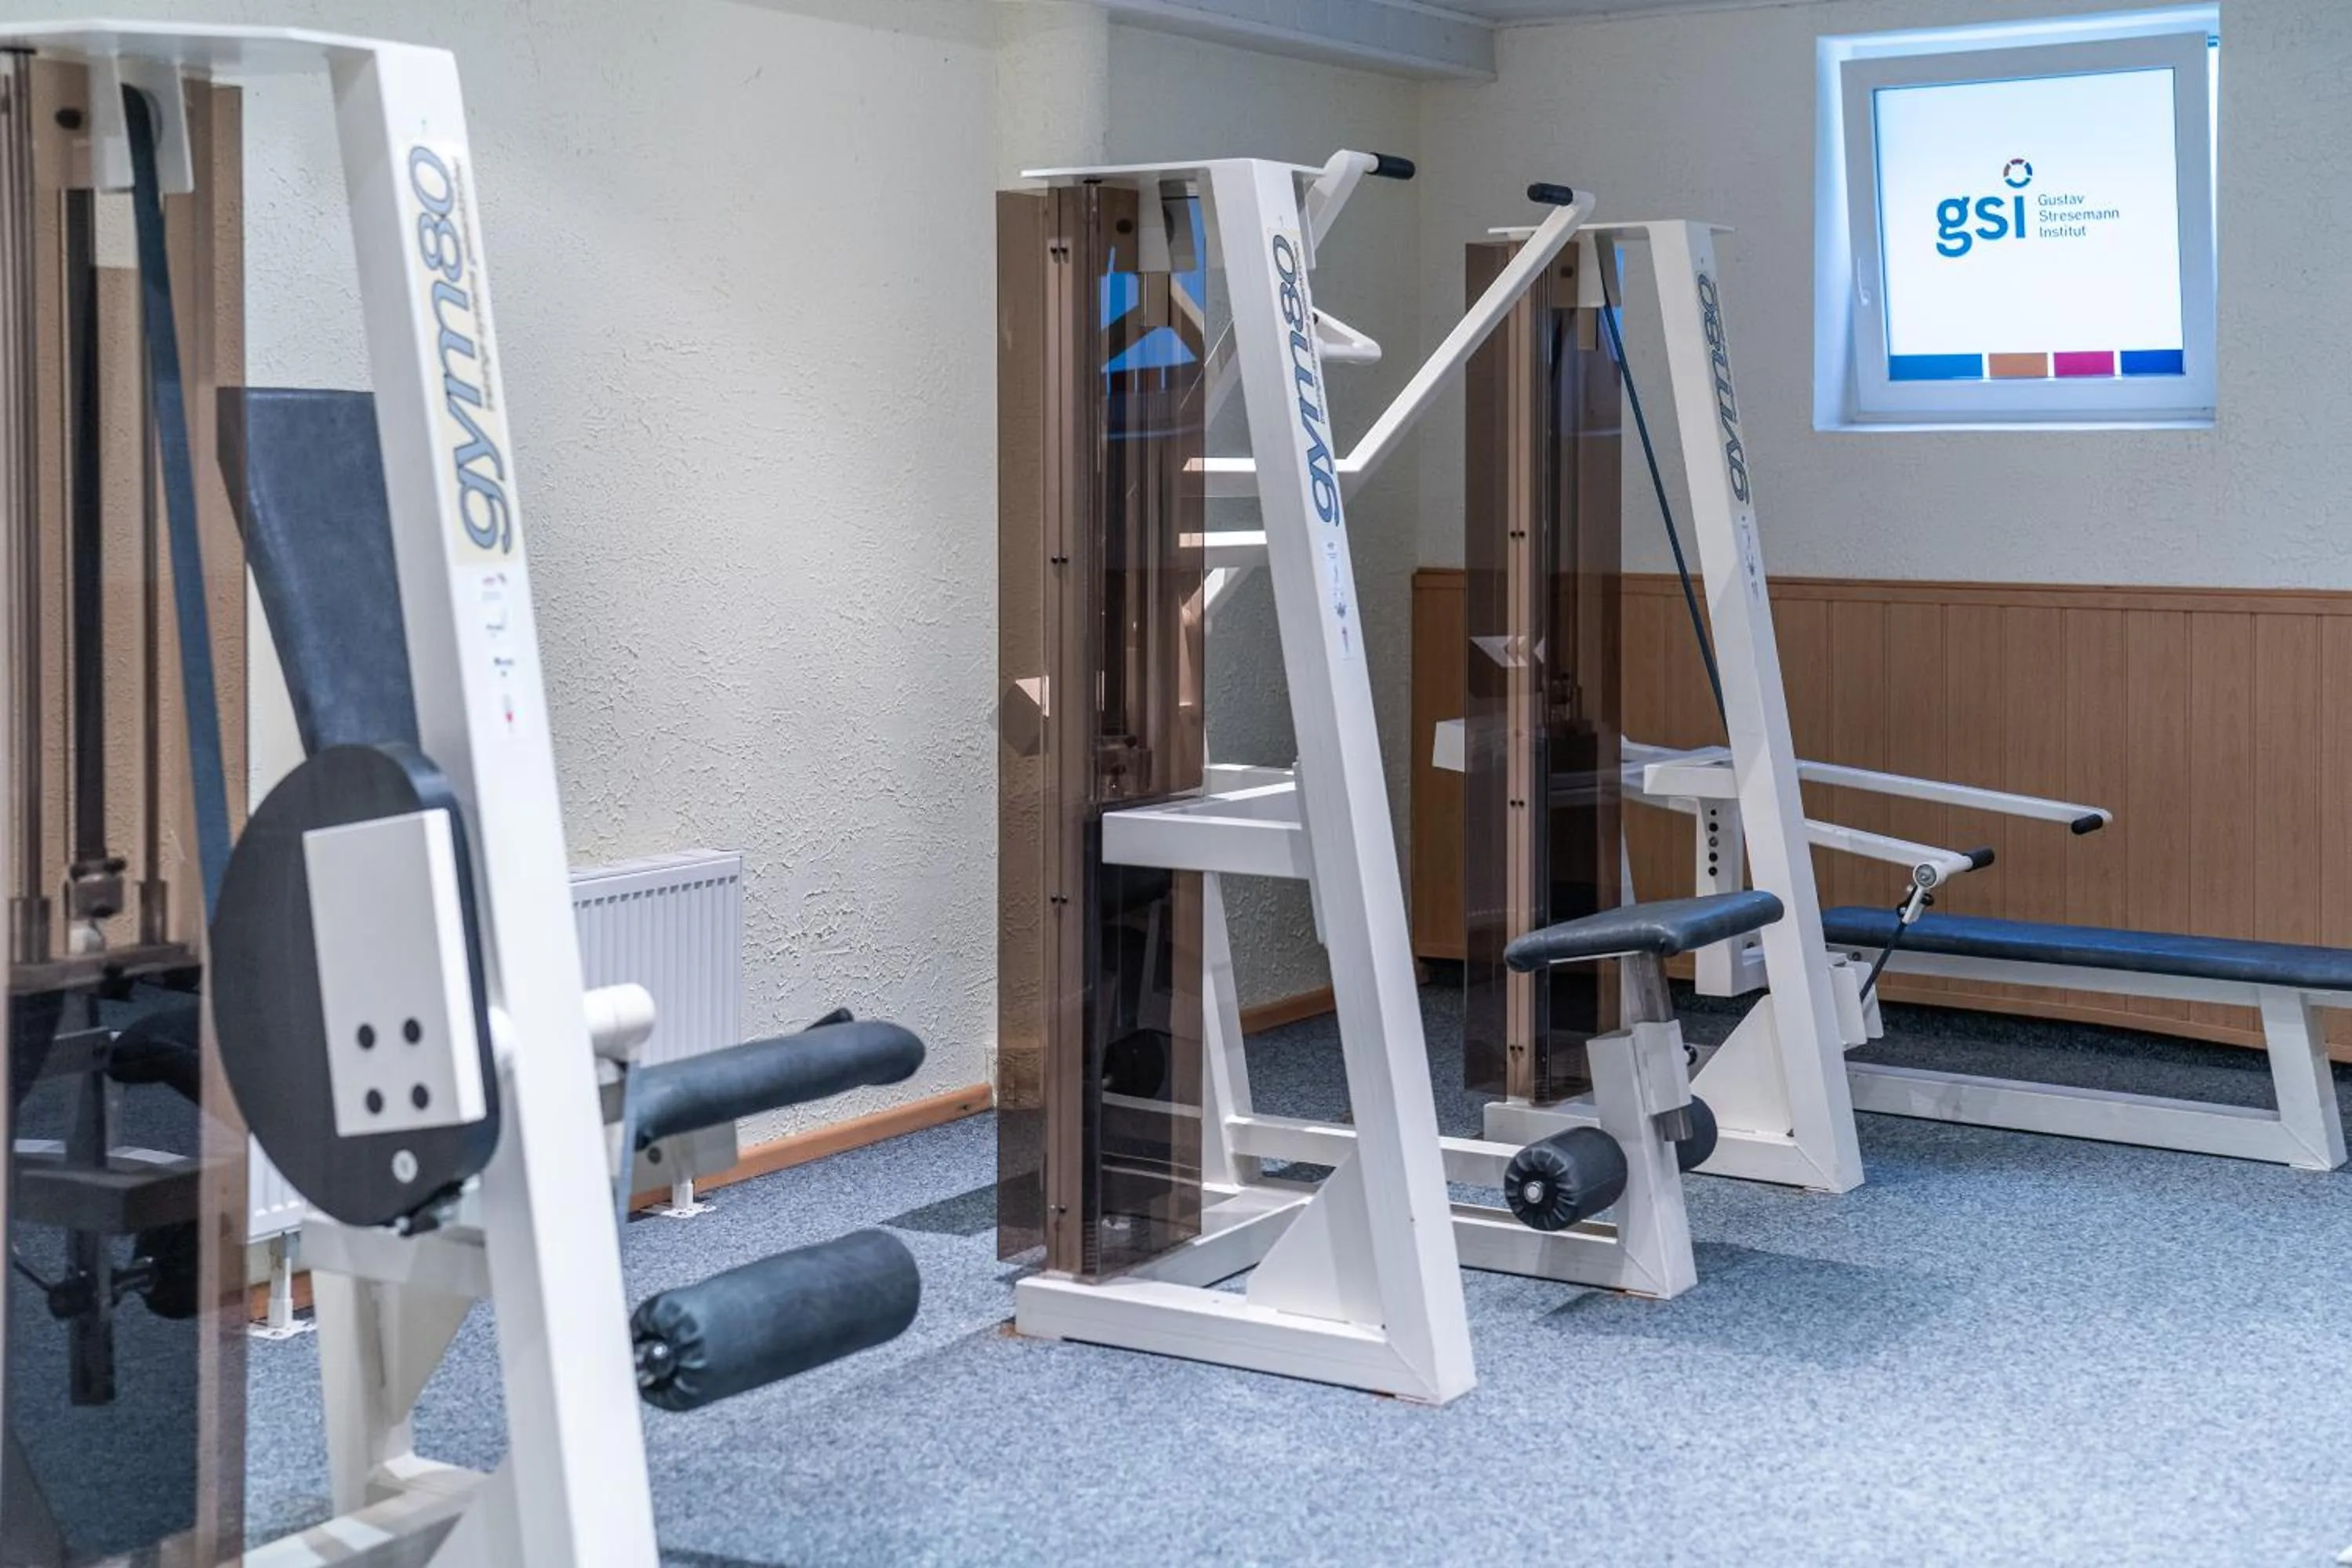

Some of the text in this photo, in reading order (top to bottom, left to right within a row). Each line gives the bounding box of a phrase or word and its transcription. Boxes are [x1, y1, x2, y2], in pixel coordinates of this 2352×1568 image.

[1936, 158, 2033, 258] gsi
[2038, 193, 2085, 206] Gustav
[2038, 209, 2120, 223] Stresemann
[2038, 224, 2087, 238] Institut
[410, 145, 511, 554] gym80
[1273, 234, 1340, 527] gym80
